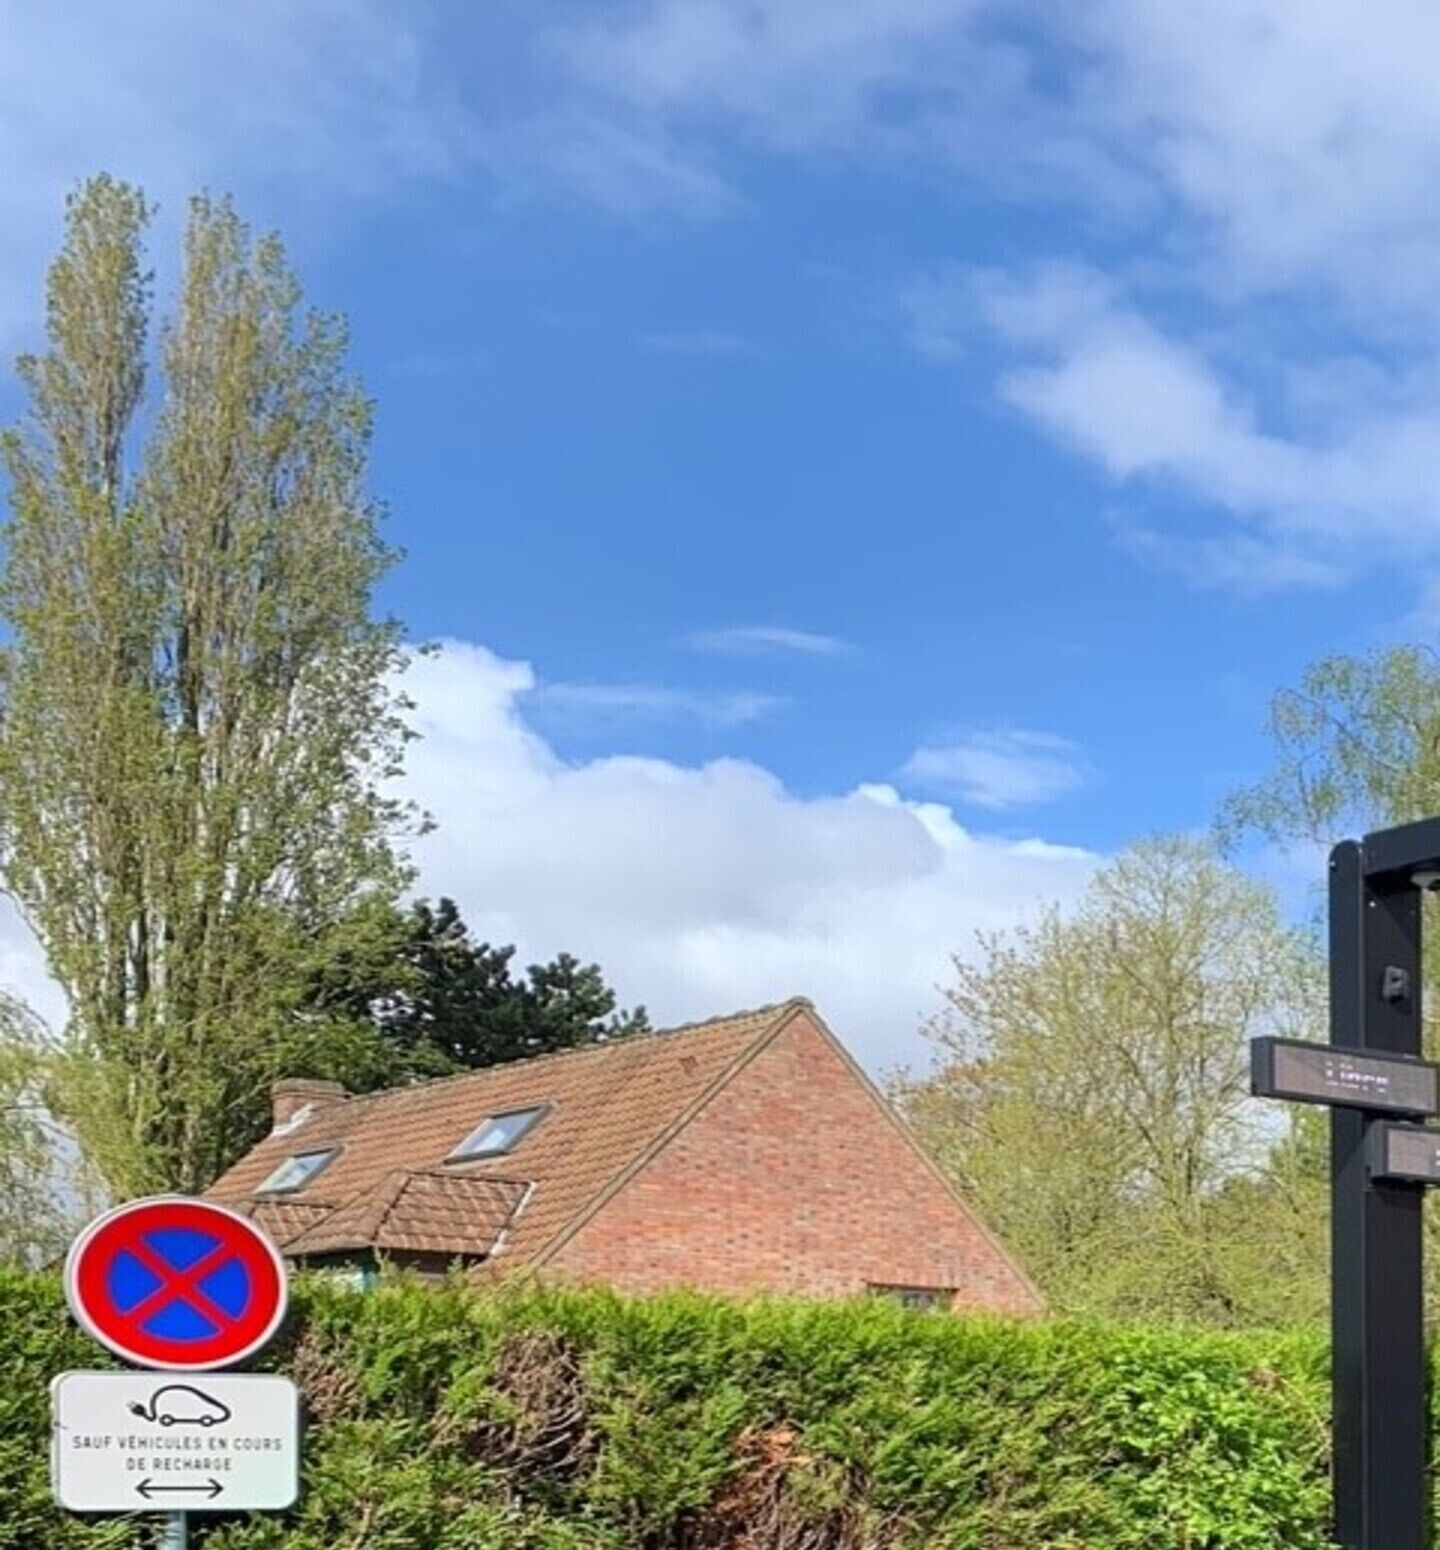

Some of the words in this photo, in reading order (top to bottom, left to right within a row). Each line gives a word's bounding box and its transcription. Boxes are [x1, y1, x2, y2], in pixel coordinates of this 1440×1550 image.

[72, 1435, 112, 1450] SAUF
[117, 1435, 202, 1451] VÉHICULES
[208, 1437, 229, 1451] EN
[233, 1437, 284, 1452] COURS
[125, 1457, 146, 1472] DE
[153, 1457, 233, 1472] RECHARGE
